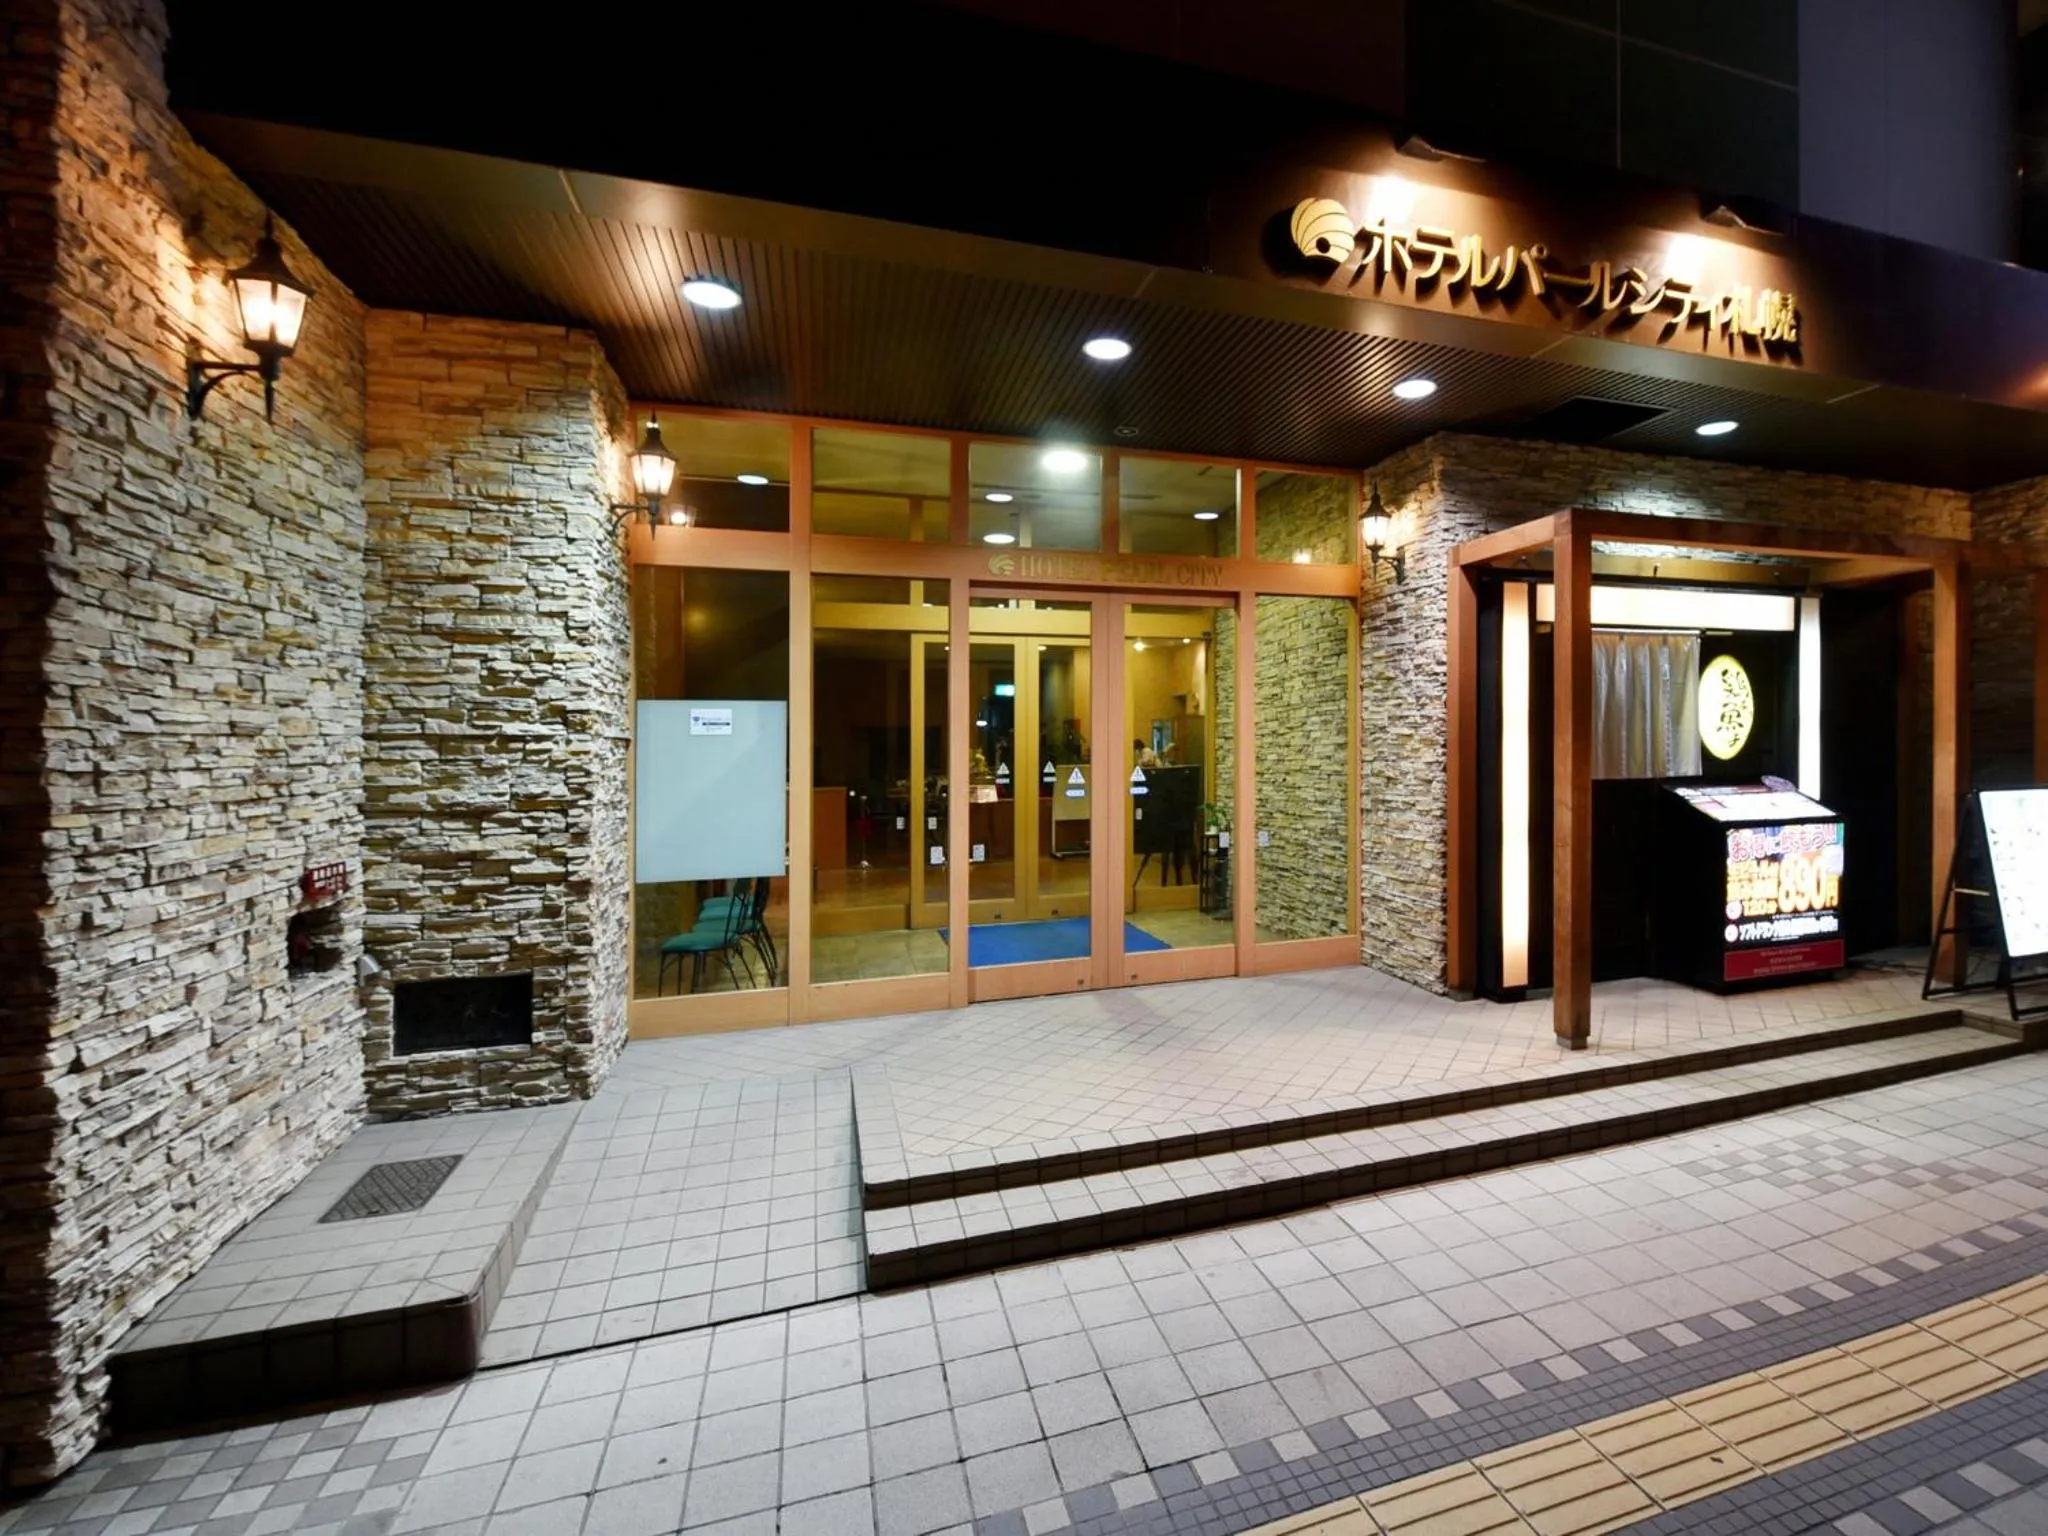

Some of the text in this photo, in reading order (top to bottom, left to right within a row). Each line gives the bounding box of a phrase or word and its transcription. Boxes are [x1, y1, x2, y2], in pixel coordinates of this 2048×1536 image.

[1360, 219, 1798, 343] ホテルパールシティ札幌
